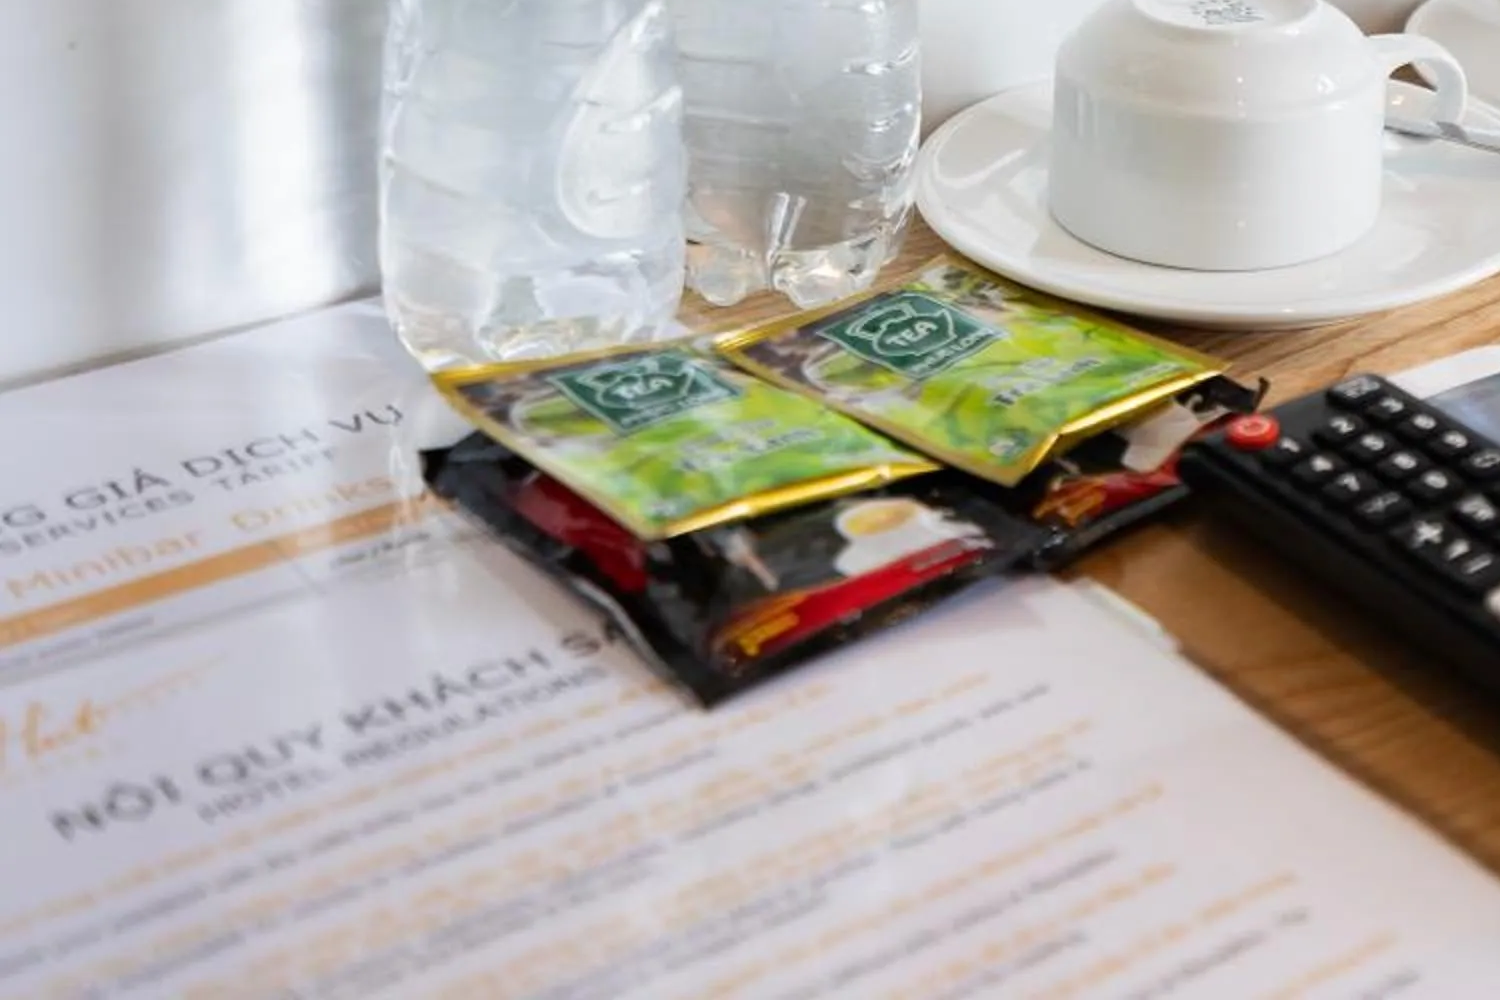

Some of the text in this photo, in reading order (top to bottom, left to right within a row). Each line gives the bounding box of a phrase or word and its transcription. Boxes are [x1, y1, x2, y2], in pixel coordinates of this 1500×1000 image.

[886, 319, 937, 349] TEA
[1330, 416, 1355, 435] 2
[0, 487, 195, 554] SERVICES
[6, 530, 203, 596] Minibar
[196, 722, 325, 786] QUY
